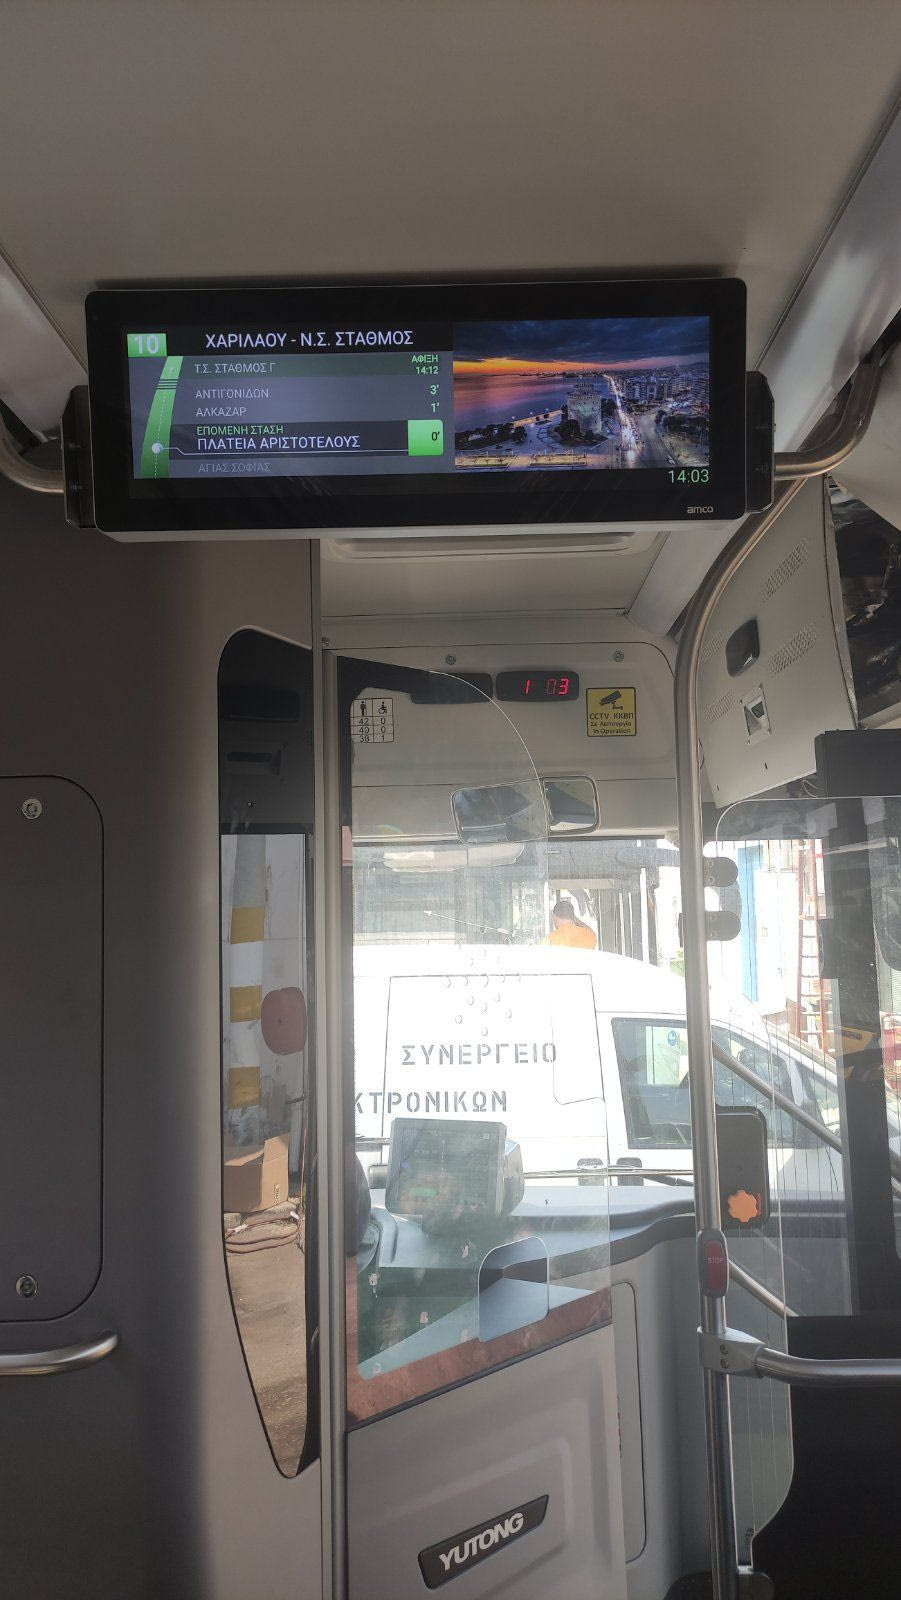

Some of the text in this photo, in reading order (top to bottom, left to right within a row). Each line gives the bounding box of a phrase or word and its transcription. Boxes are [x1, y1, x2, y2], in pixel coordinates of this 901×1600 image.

[133, 335, 160, 354] 10
[205, 332, 287, 348] ΧΑΡΙΛΑΟΥ
[300, 332, 331, 347] Ν.Σ.
[335, 330, 414, 346] ΣΤΑΘΜΟΣ
[411, 354, 439, 363] ΑΦΙΞΗ
[194, 362, 276, 374] Τ.Σ. ΣΤΑΘΜΟΣ Γ
[415, 365, 439, 375] 14:12
[195, 388, 269, 399] ΑΝΤΙΓΟΝΙΔΩΝ
[196, 406, 247, 417] ΑΛΚΑΖΑΡ
[196, 425, 284, 436] ΕΠΟΜΕΝΗ ΣΤΑΣΗ
[197, 435, 361, 450] ΠΛΑΤΕΙΑ ΑΡΙΣΤΟΤΕΛΟΥΣ
[198, 462, 272, 473] ΑΓΙΑΣ ΣΟΦΙΑΣ
[668, 469, 709, 483] 14:03
[687, 505, 714, 514] amco
[358, 717, 369, 725] 42
[380, 725, 387, 734] 0
[402, 1042, 556, 1065] ΣΥΝΕΡΓΕΙΟ
[439, 1513, 524, 1571] YUTONG
